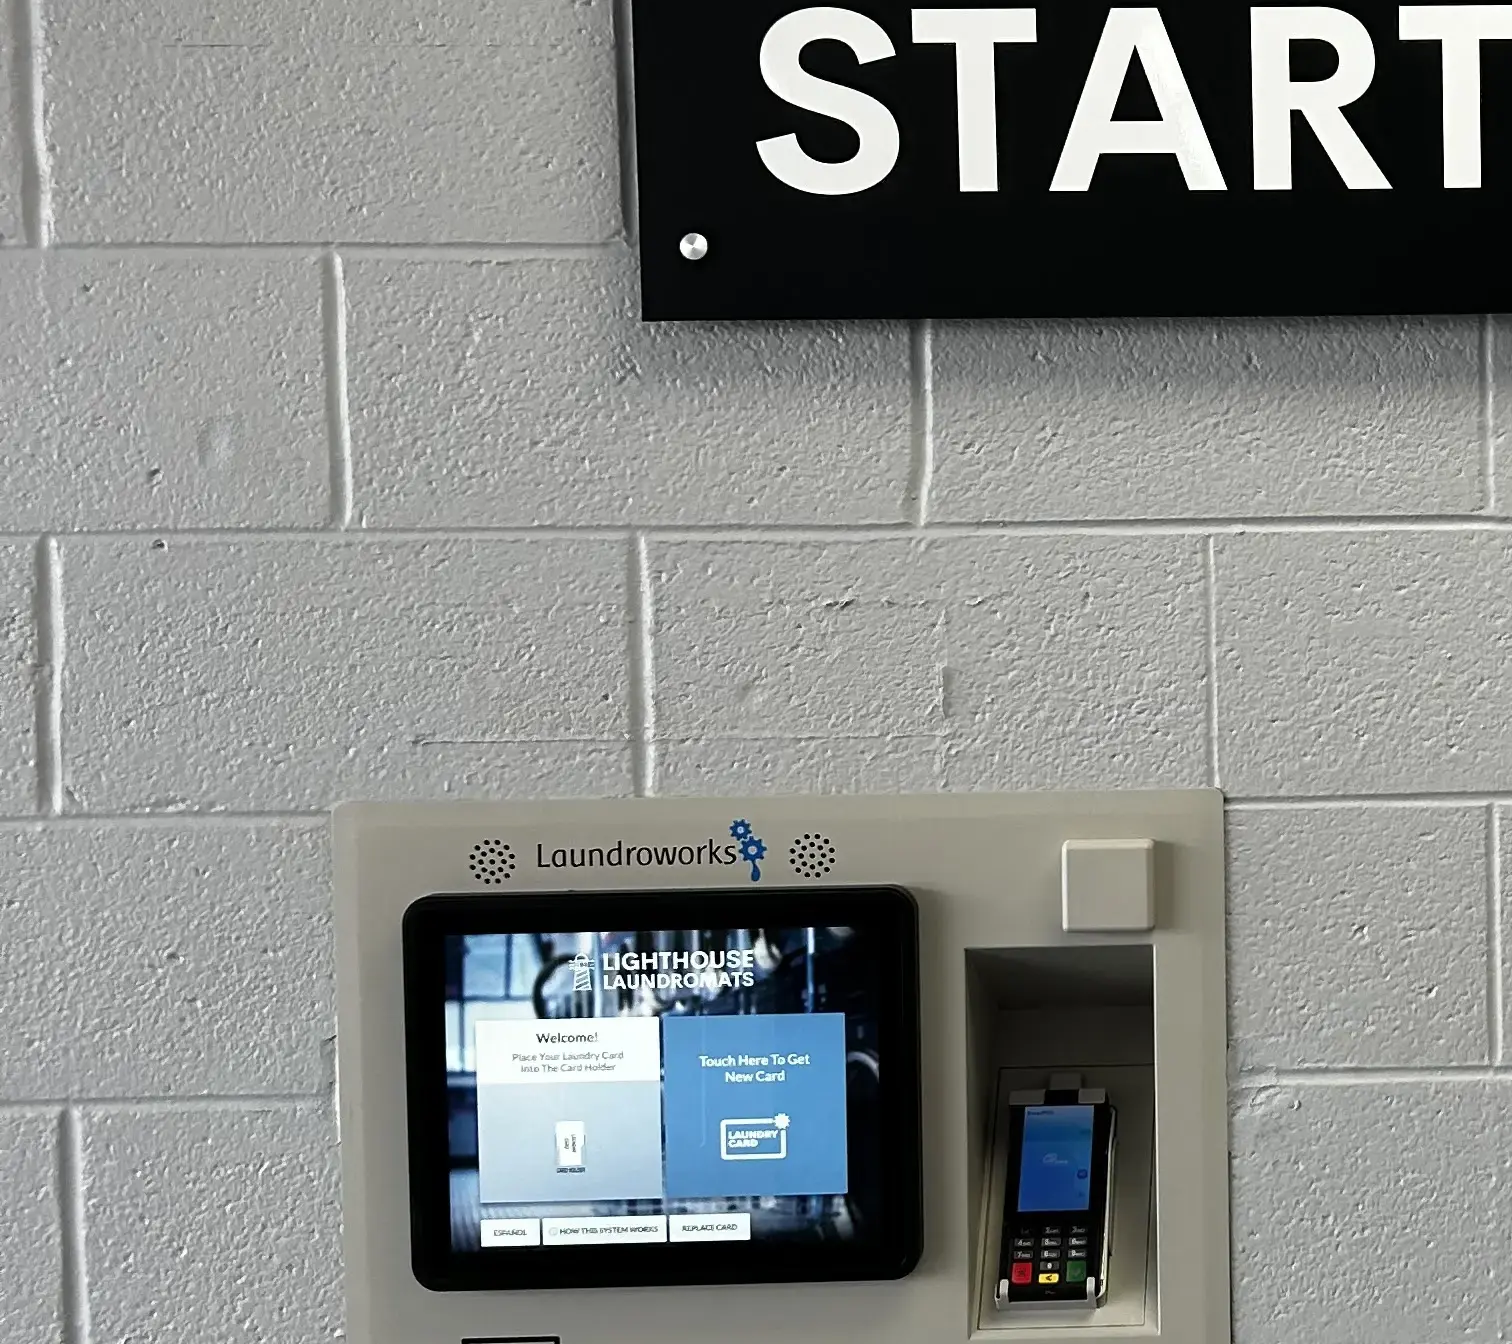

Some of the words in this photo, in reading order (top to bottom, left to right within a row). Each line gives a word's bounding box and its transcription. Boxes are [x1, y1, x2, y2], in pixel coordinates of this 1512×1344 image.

[537, 839, 737, 868] Laundroworks
[603, 950, 754, 971] LIGHTHOUSE
[603, 971, 755, 990] LAUNDROMATS
[536, 1031, 598, 1044] Welcome!
[512, 1052, 536, 1062] Place
[539, 1052, 560, 1062] Your
[562, 1051, 600, 1063] Laundry
[602, 1051, 624, 1061] Card
[699, 1054, 736, 1067] Touch
[738, 1054, 768, 1066] Here
[770, 1054, 786, 1066] To
[787, 1053, 810, 1066] Get
[542, 1063, 558, 1072] The
[560, 1063, 582, 1072] Card
[584, 1062, 616, 1072] Holder
[725, 1071, 753, 1083] New
[755, 1070, 785, 1082] Card
[728, 1129, 778, 1140] LAUNDRY
[728, 1138, 758, 1148] CARD
[559, 1227, 580, 1236] HOW
[600, 1226, 629, 1235] SYSTEM
[630, 1225, 658, 1234] WORKS
[716, 1223, 738, 1232] CARD
